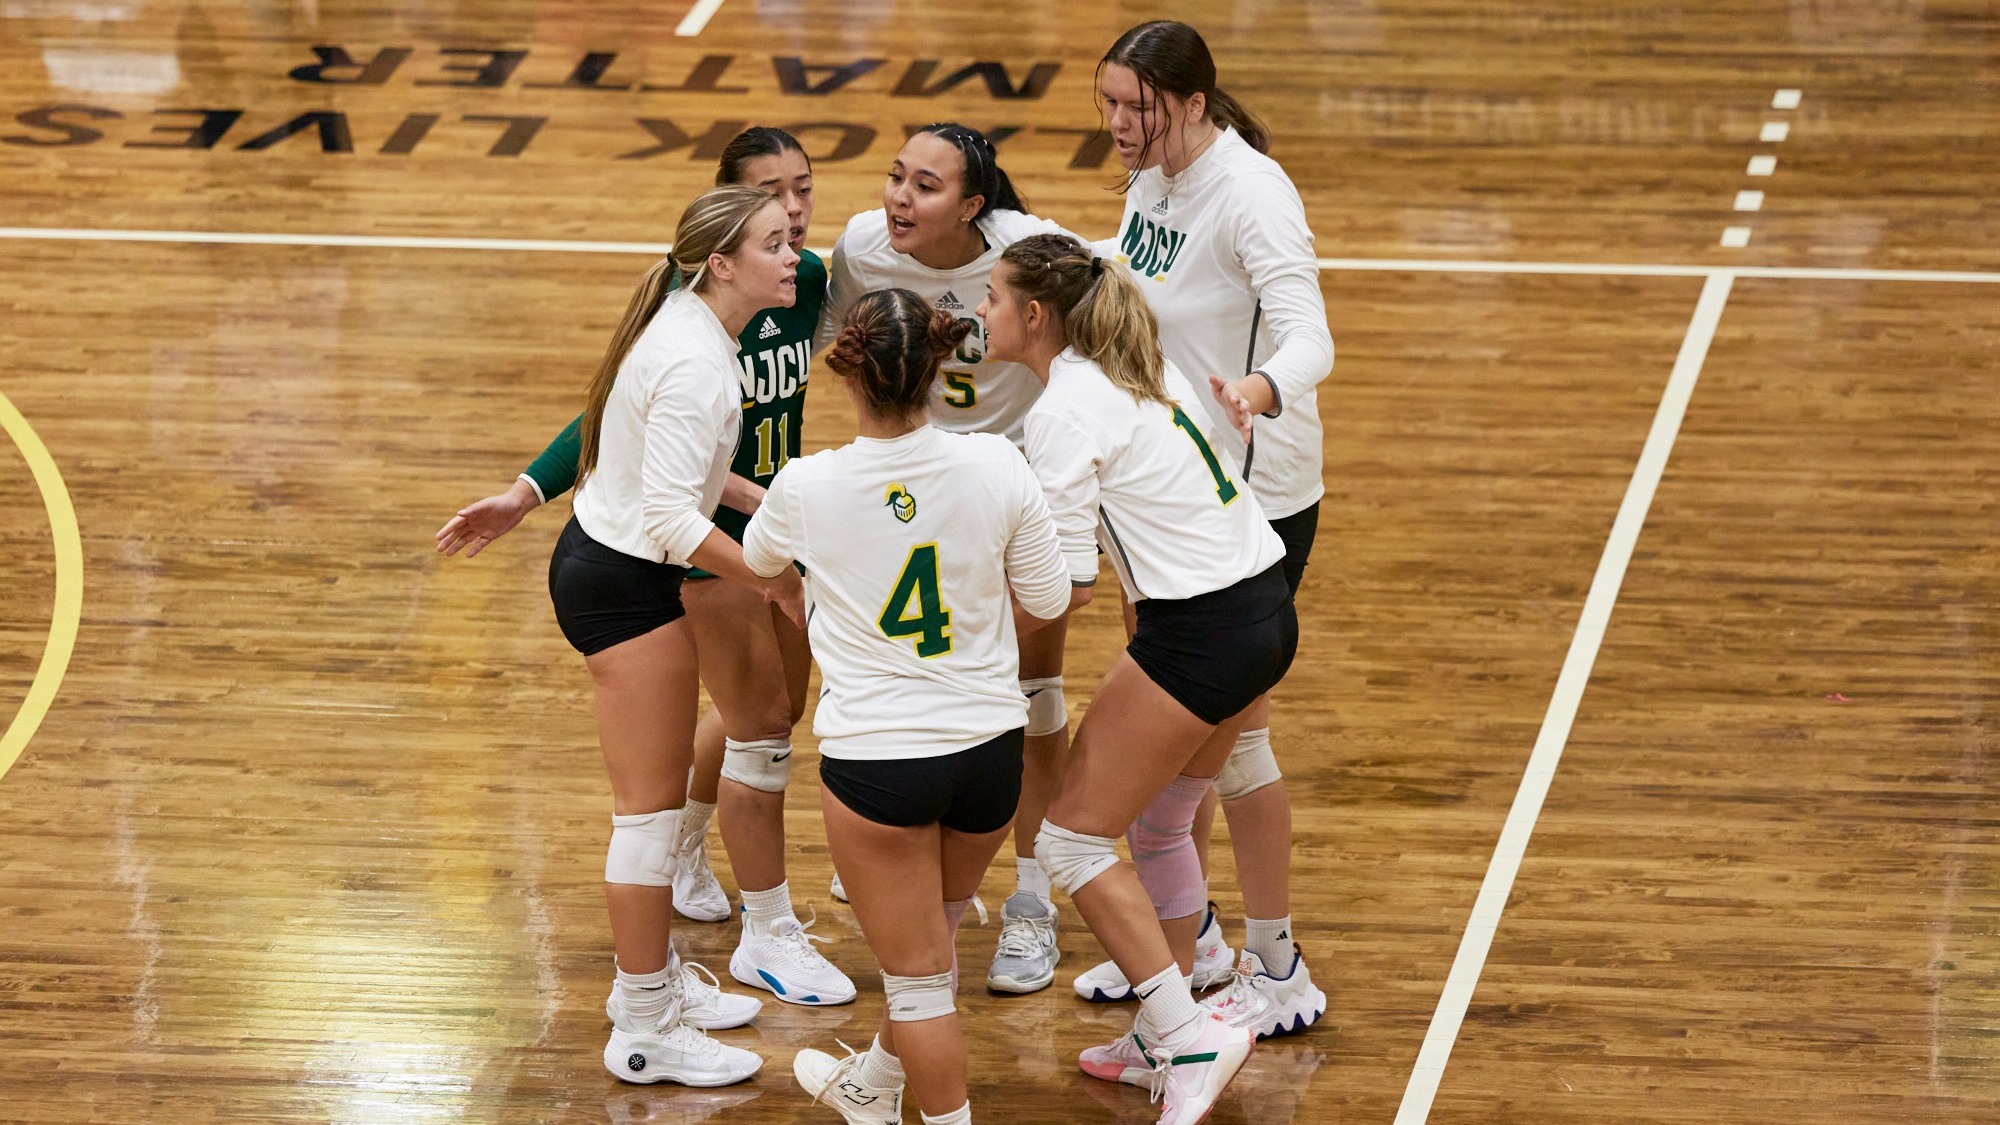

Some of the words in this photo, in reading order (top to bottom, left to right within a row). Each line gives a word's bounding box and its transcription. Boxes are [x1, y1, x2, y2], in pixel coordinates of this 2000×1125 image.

[288, 46, 1062, 100] MATTER
[1, 104, 549, 157] LIVES
[1121, 210, 1187, 278] NJCU
[758, 326, 781, 340] adidas
[935, 302, 964, 310] adidas
[737, 338, 811, 404] NJCU
[940, 369, 977, 410] 5
[754, 412, 789, 477] 11
[1169, 402, 1240, 507] 1
[876, 541, 954, 660] 4
